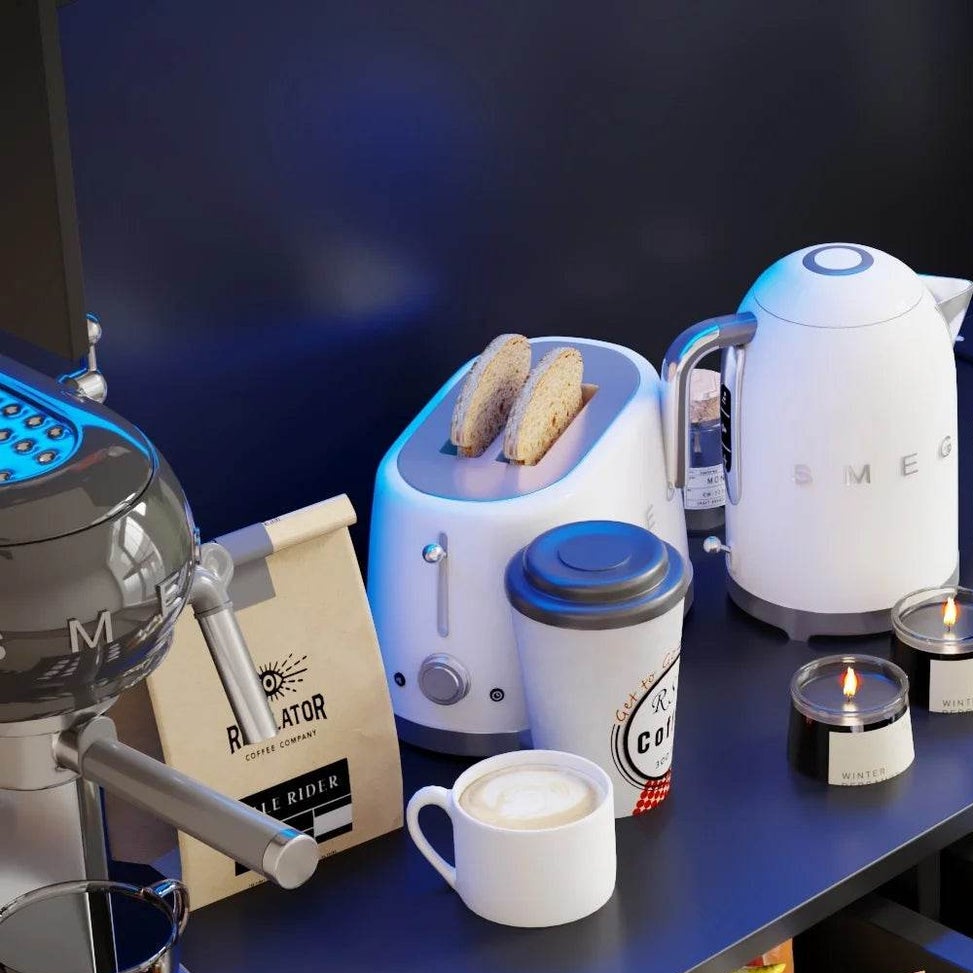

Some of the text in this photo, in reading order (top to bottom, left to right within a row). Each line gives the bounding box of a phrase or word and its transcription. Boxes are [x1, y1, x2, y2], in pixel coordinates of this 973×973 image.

[793, 434, 952, 487] SMEG
[226, 693, 328, 755] RATOR
[244, 729, 318, 762] COFFEE COMPANY
[287, 774, 339, 806] RIDER
[841, 767, 887, 780] WINTER
